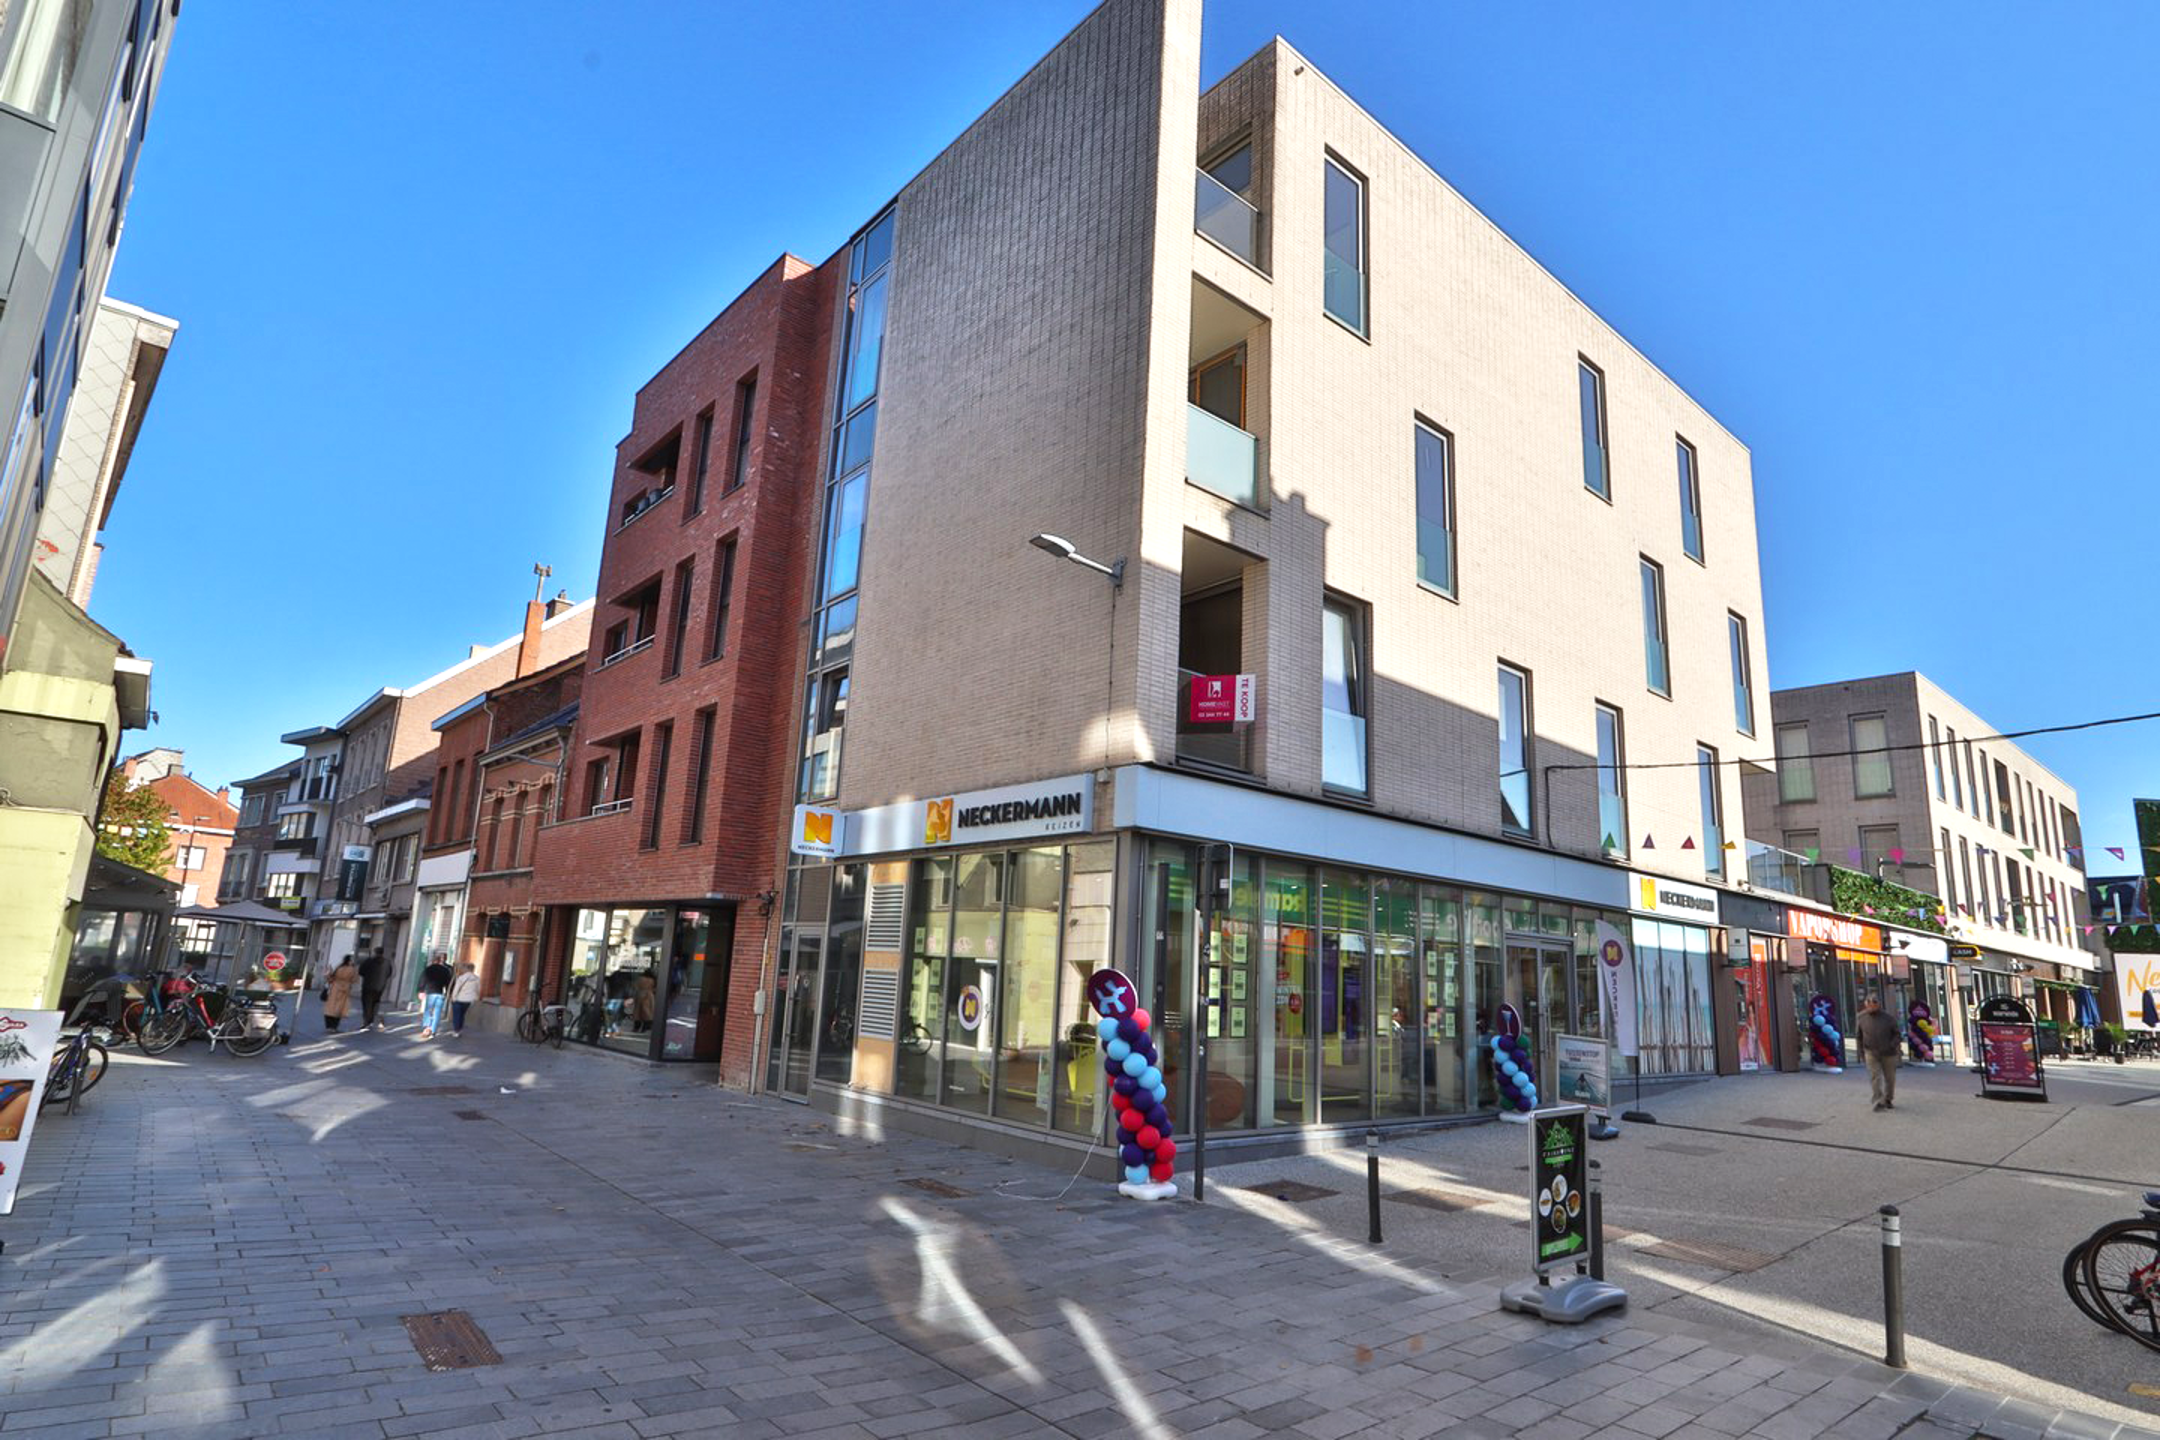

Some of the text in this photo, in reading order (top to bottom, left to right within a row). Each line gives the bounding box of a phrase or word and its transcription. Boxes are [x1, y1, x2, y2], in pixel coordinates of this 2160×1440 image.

[1240, 692, 1249, 718] KOOP
[957, 792, 1082, 829] NECKERMANN
[1044, 821, 1082, 832] REIZEN
